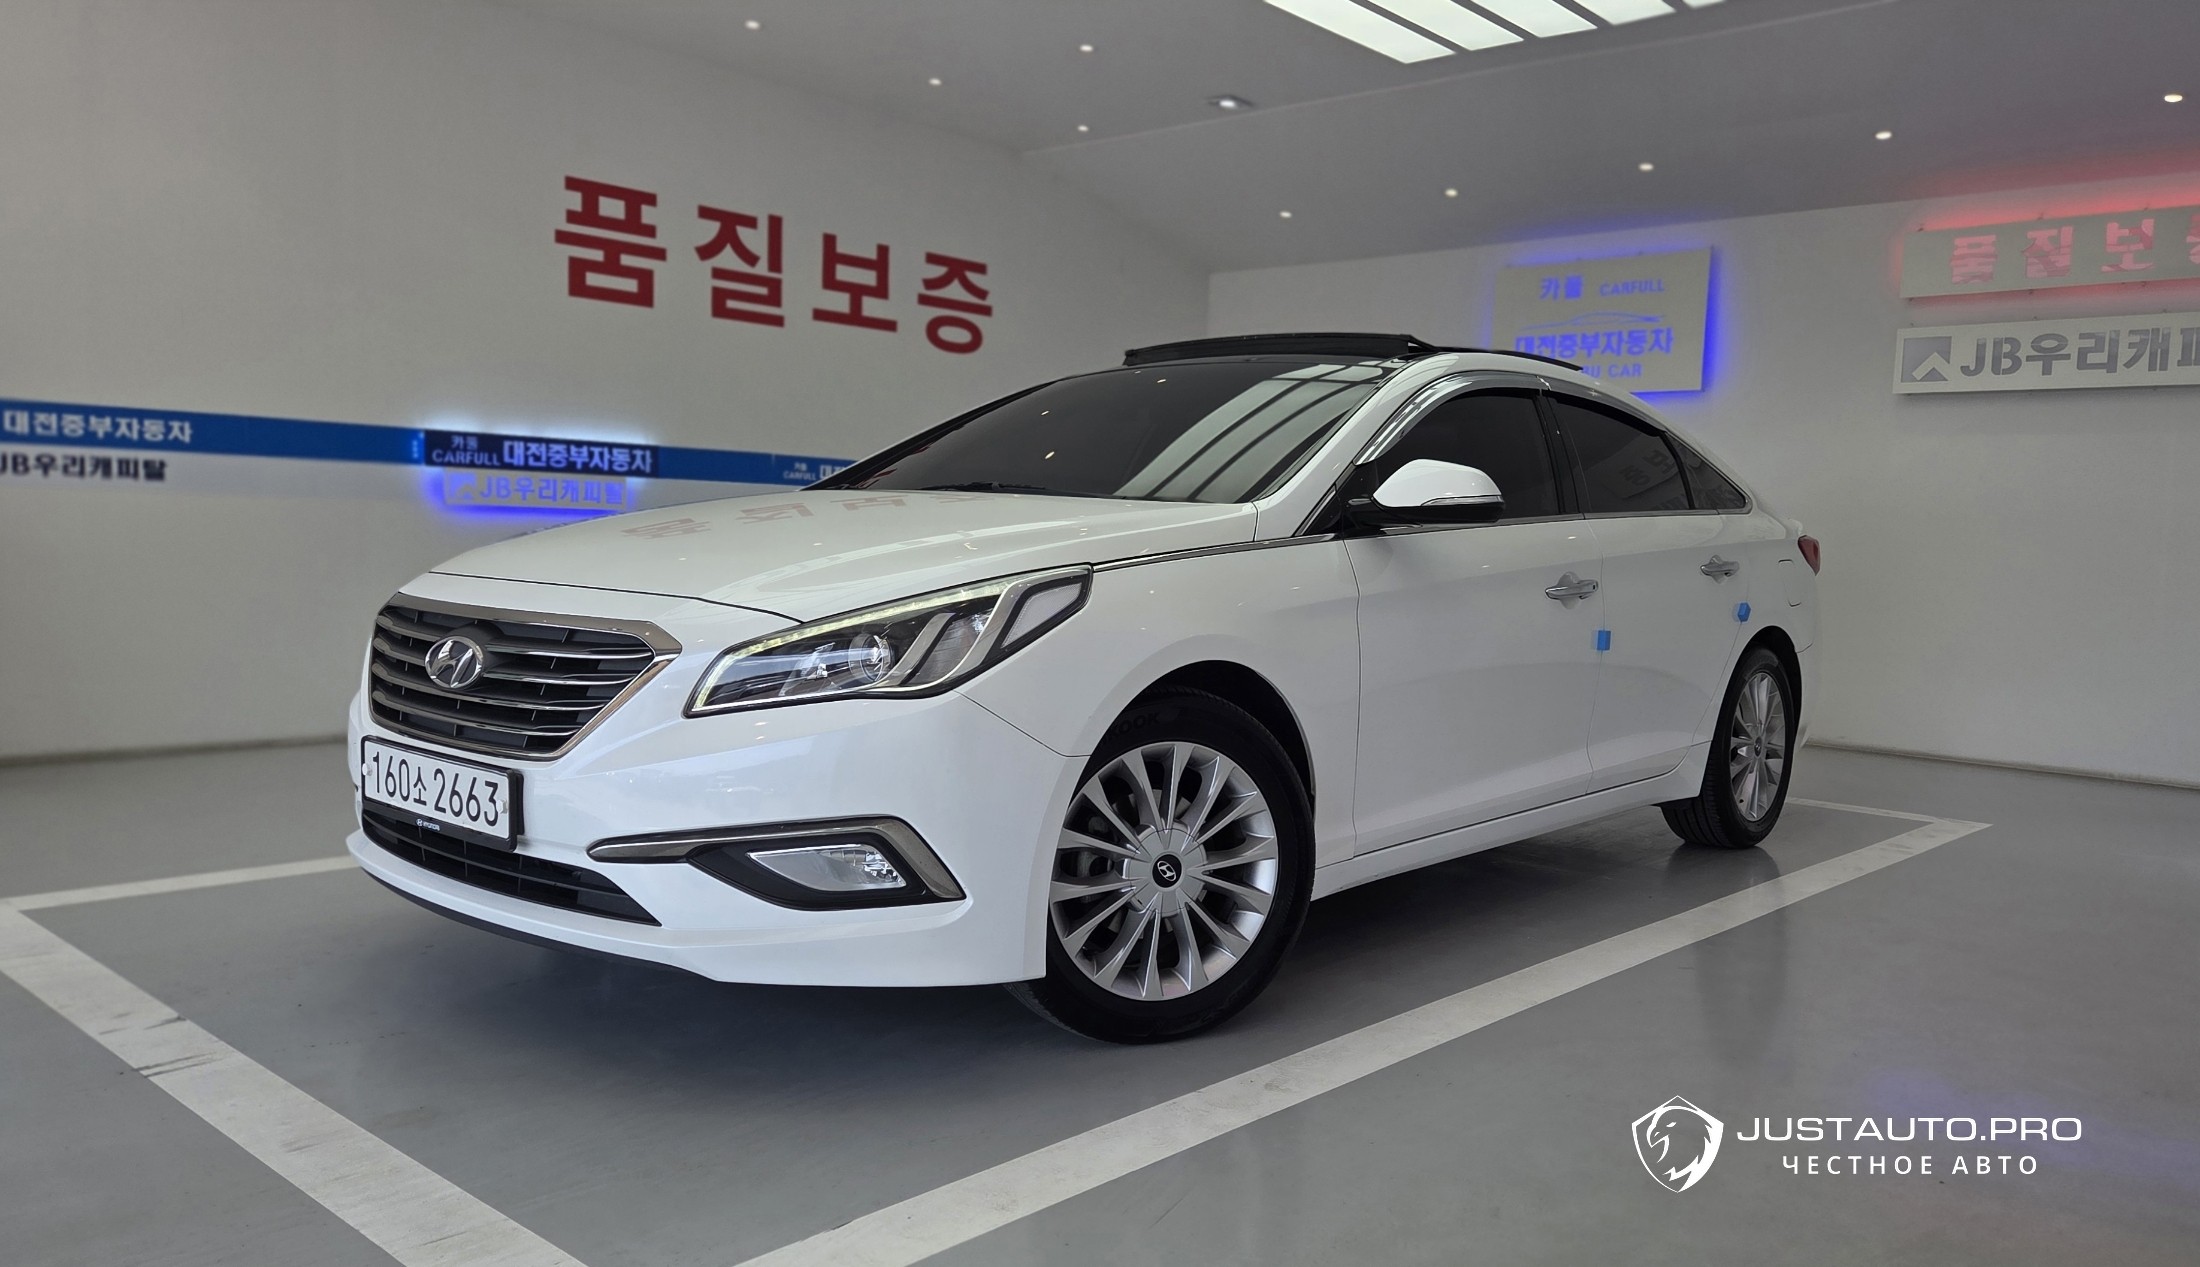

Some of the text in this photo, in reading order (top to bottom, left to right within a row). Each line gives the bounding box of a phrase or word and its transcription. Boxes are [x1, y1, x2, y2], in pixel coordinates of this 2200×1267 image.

[555, 175, 993, 355] 품질보증
[1951, 213, 2200, 284] 품질보
[1599, 279, 1665, 297] CARFULL
[1515, 327, 1674, 360] 대전중부자동차
[1607, 362, 1643, 379] CAR
[3, 410, 193, 443] 대전중부자동차
[432, 449, 500, 466] CARFULL
[503, 440, 653, 473] 대전중부자동차
